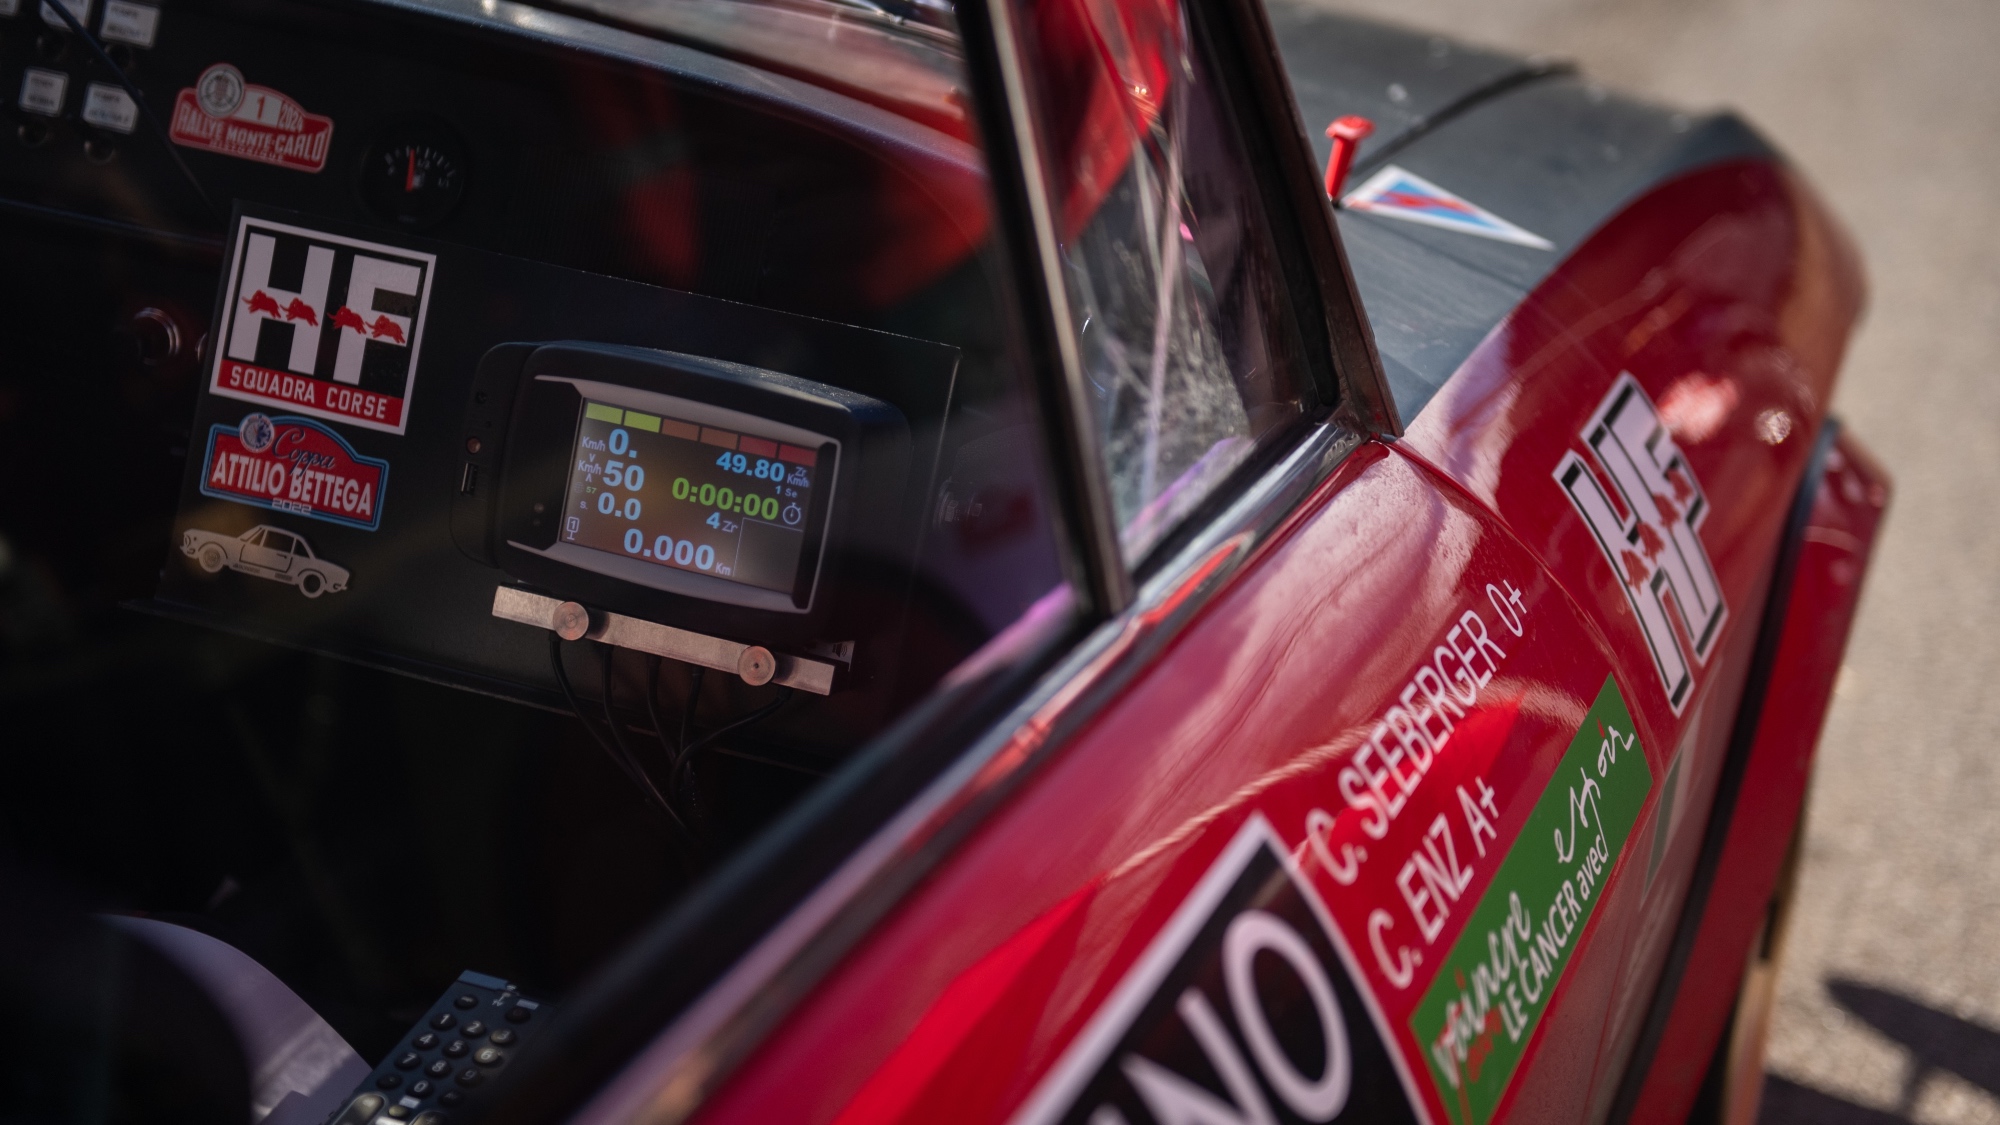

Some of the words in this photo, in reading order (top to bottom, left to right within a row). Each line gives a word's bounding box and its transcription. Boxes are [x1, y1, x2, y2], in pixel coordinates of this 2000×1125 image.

[176, 101, 224, 143] RALLYE
[227, 124, 328, 162] MONTE-CARLO
[228, 232, 421, 386] HF
[229, 365, 316, 404] SQUADRA
[325, 387, 388, 420] CORSE
[272, 428, 336, 476] Coppa
[581, 436, 606, 452] Km/h
[212, 450, 285, 496] ATTILIO
[288, 467, 372, 516] BETTEGA
[577, 459, 602, 475] Km/h
[602, 459, 645, 491] 50
[716, 451, 785, 482] 49.80
[786, 473, 810, 488] Km/h
[272, 497, 312, 515] 2022
[597, 492, 642, 521] 0.0
[672, 477, 779, 521] 0:00:00
[775, 485, 781, 495] 1
[705, 512, 721, 529] 4
[624, 528, 715, 570] 0.000
[715, 562, 732, 576] Km
[1552, 369, 1729, 719] HF
[1305, 807, 1368, 885] C.
[1338, 609, 1507, 840] SEEBERGER
[1367, 907, 1424, 989] C.
[1396, 813, 1474, 945] ENZ
[1456, 776, 1499, 858] A+
[1499, 982, 1529, 1044] LE
[1519, 880, 1582, 1005] CANCER
[1576, 834, 1608, 901] avec
[439, 1013, 451, 1025] 1
[467, 1020, 481, 1033] 2
[1088, 908, 1352, 1125] NO
[403, 1052, 416, 1065] 7
[431, 1060, 447, 1073] 8
[419, 1032, 434, 1045] 4
[451, 1039, 465, 1052] 5
[480, 1049, 493, 1061] 6
